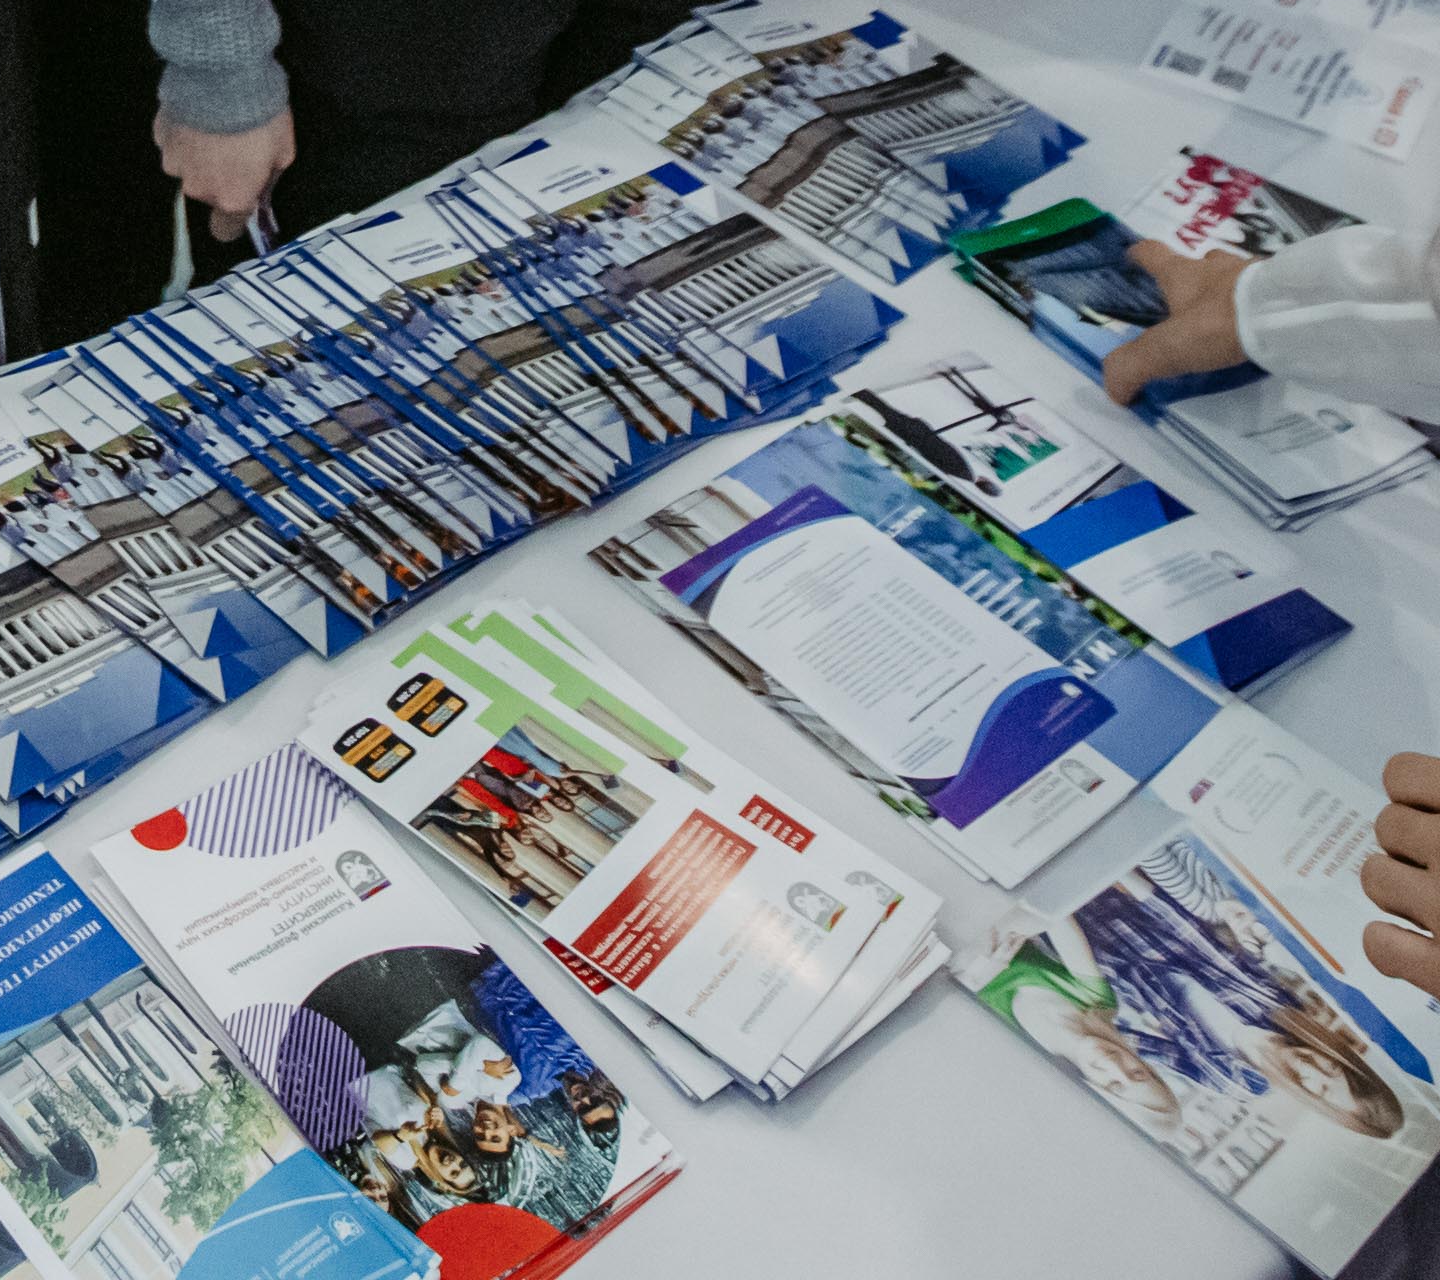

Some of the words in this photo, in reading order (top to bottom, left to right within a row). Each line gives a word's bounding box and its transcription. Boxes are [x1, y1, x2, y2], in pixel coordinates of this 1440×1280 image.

[261, 862, 308, 893] массовых
[278, 875, 335, 912] ИНСТИТУТ
[270, 888, 346, 937] УНИВЕРСИТЕТ
[301, 899, 356, 936] Казанский
[21, 919, 103, 980] ИНСТИТУТ
[176, 934, 201, 951] наук
[227, 930, 300, 976] федеральный
